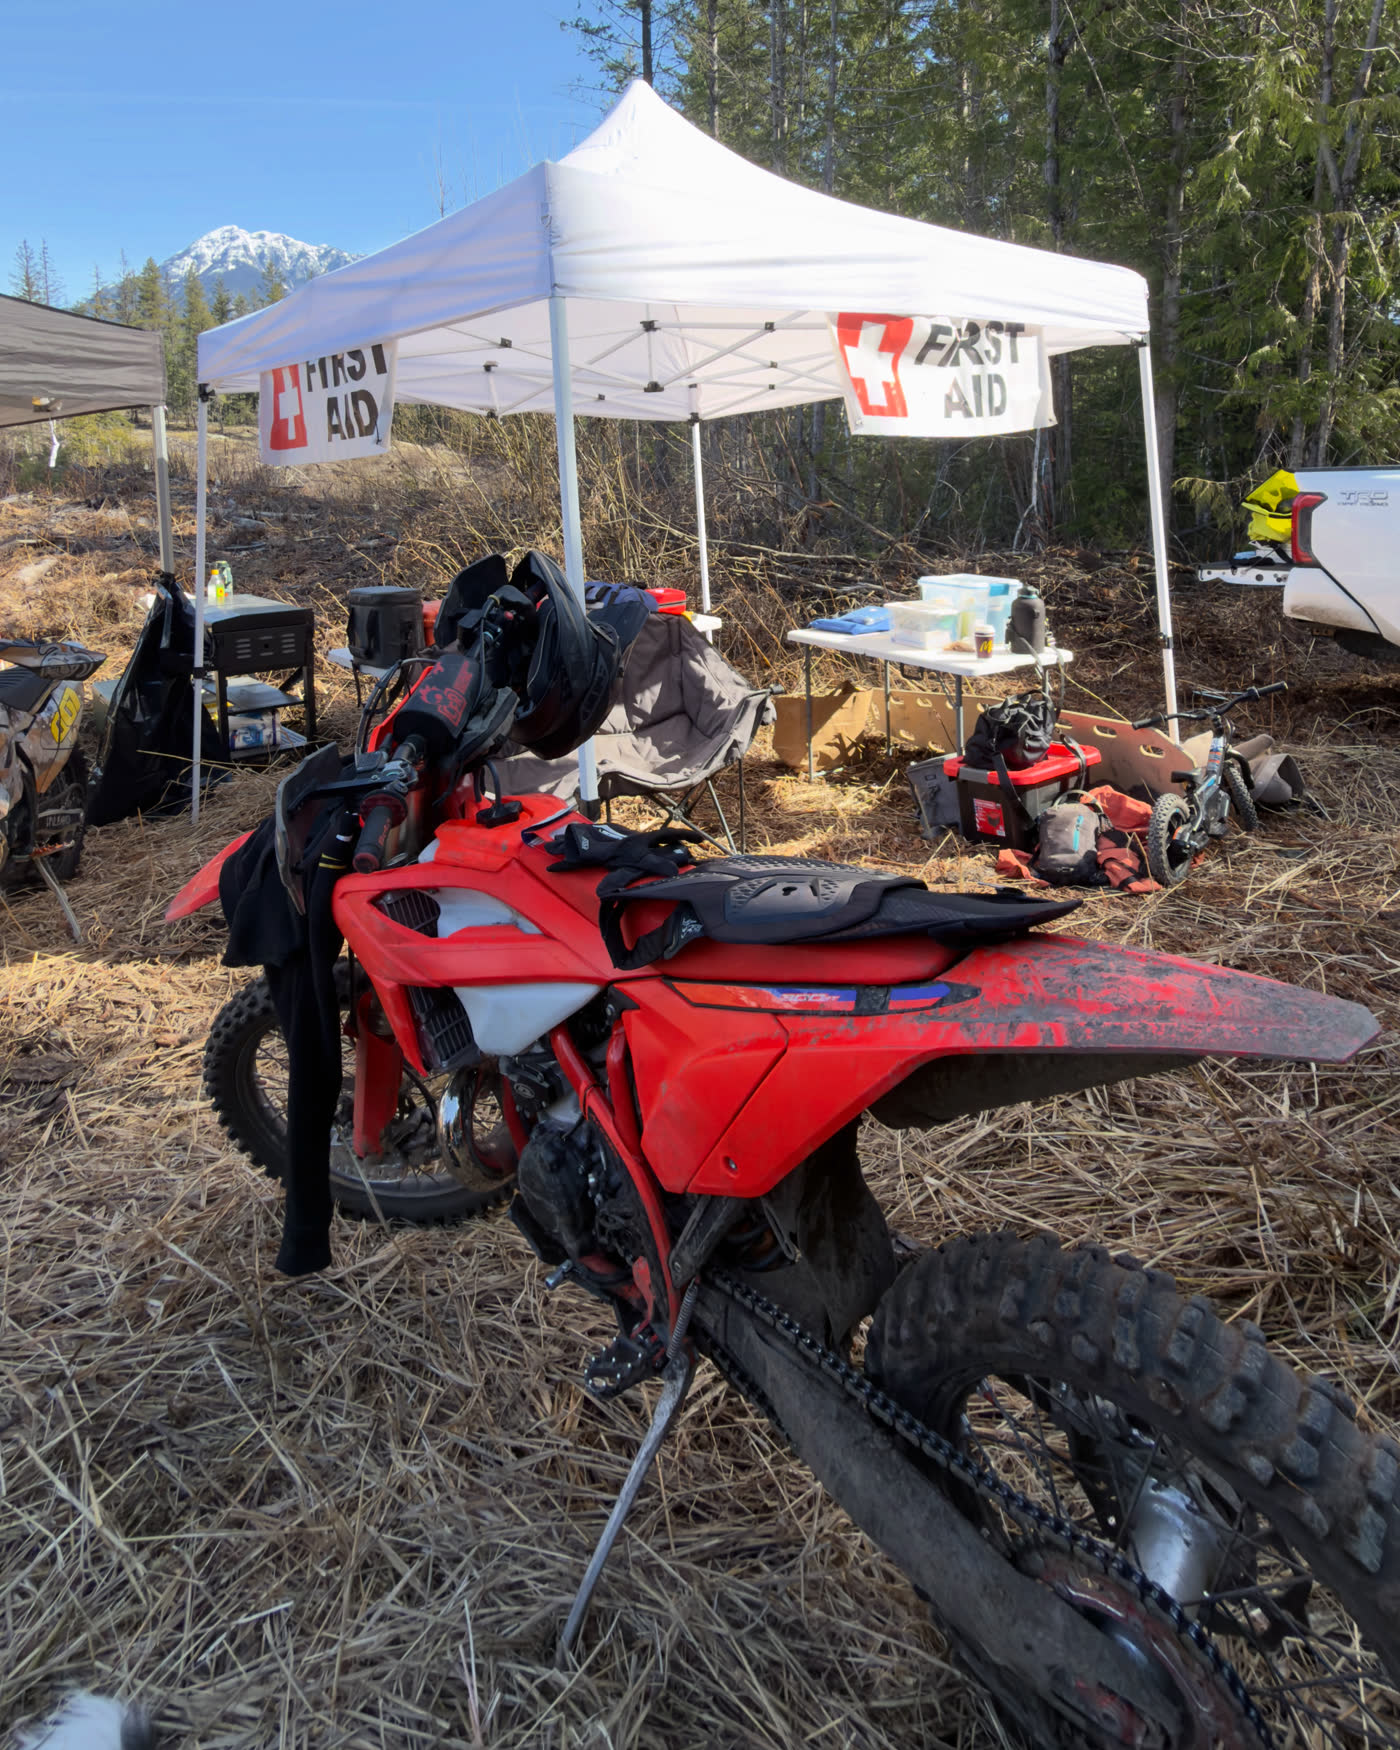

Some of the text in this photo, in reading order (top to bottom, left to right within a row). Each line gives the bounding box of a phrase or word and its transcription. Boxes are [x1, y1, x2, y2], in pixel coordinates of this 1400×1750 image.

[914, 321, 1025, 367] FIRST
[326, 389, 379, 442] AID
[944, 373, 1008, 419] AID
